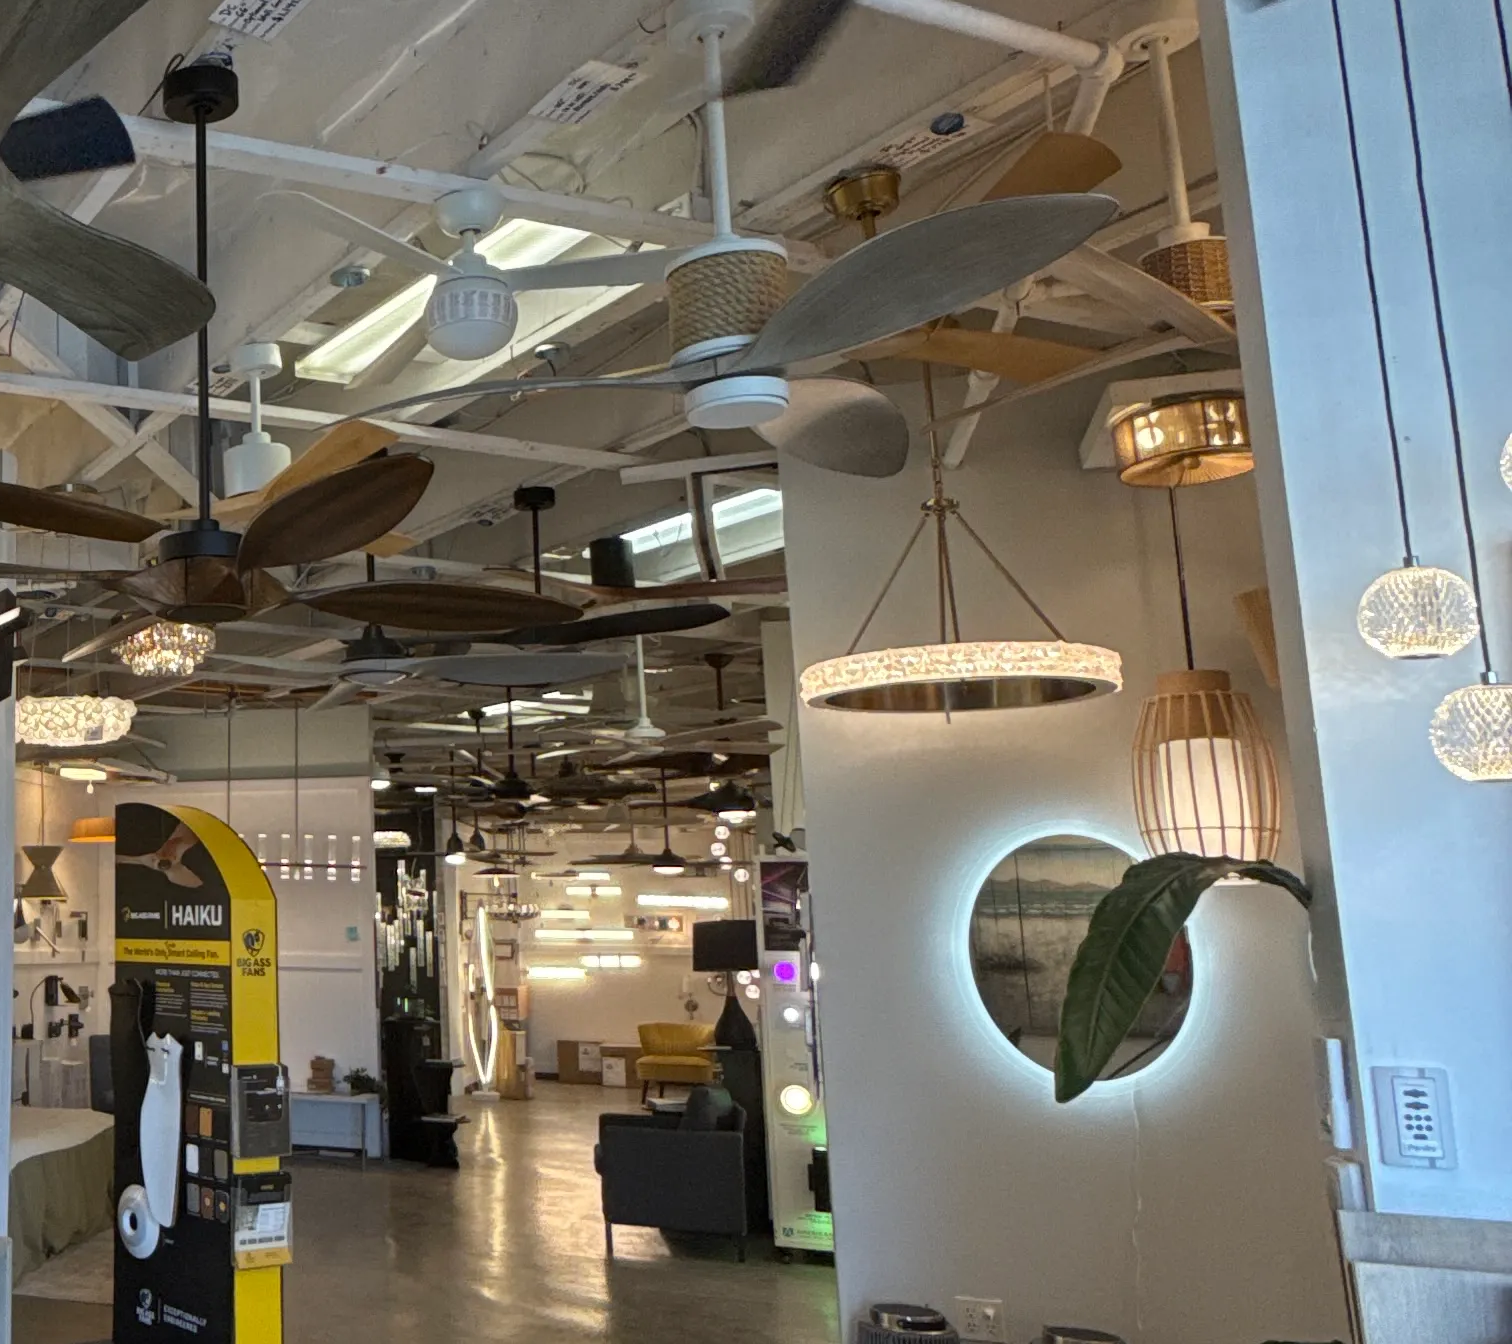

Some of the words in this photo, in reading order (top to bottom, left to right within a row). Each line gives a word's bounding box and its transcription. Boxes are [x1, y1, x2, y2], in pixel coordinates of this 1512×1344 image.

[171, 905, 223, 926] HAIKU
[237, 958, 251, 967] BIG
[253, 958, 271, 967] ASS
[242, 968, 266, 976] FANS
